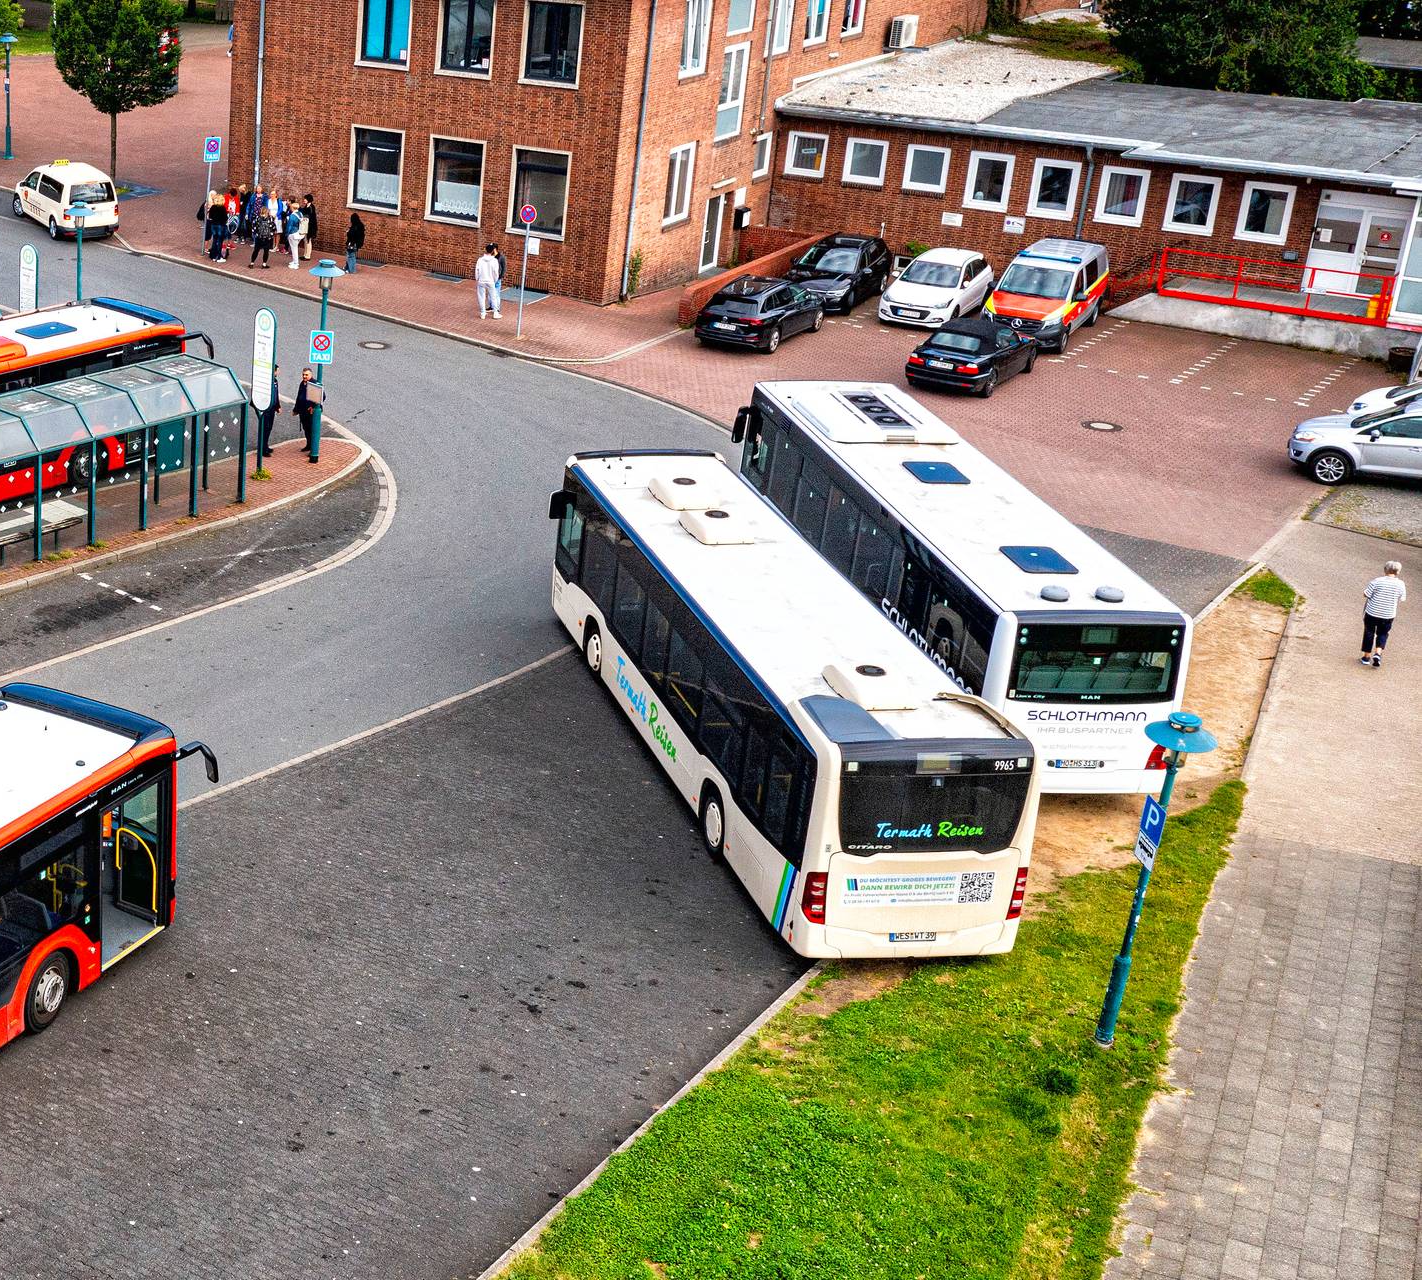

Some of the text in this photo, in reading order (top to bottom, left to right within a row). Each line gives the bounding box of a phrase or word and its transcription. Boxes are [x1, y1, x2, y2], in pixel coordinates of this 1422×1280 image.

[311, 353, 331, 361] TAXI
[617, 655, 677, 762] Termath Reisen
[1027, 710, 1147, 721] SCHLOTHMANN
[994, 760, 1015, 771] 9965
[111, 782, 127, 795] MAN
[1144, 803, 1160, 830] P
[876, 821, 984, 839] Termath Reisen
[895, 932, 910, 940] WES
